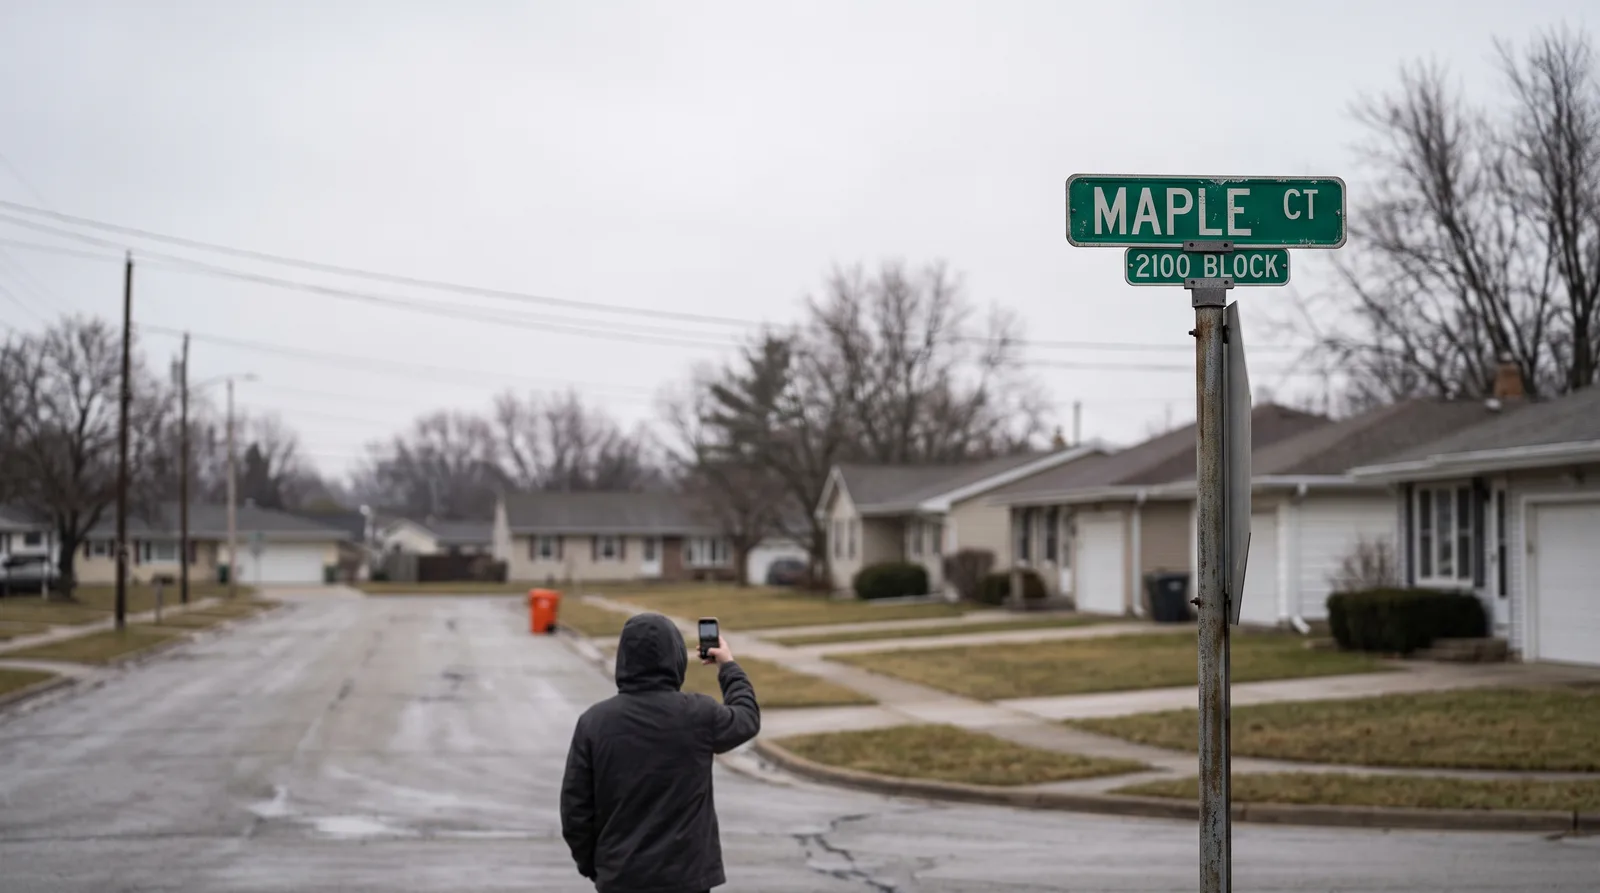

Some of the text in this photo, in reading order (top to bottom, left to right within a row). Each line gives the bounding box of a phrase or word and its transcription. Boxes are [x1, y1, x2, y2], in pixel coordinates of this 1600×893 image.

[1094, 186, 1319, 236] MAPLE CT
[1136, 254, 1279, 278] 2100 BLOCK
